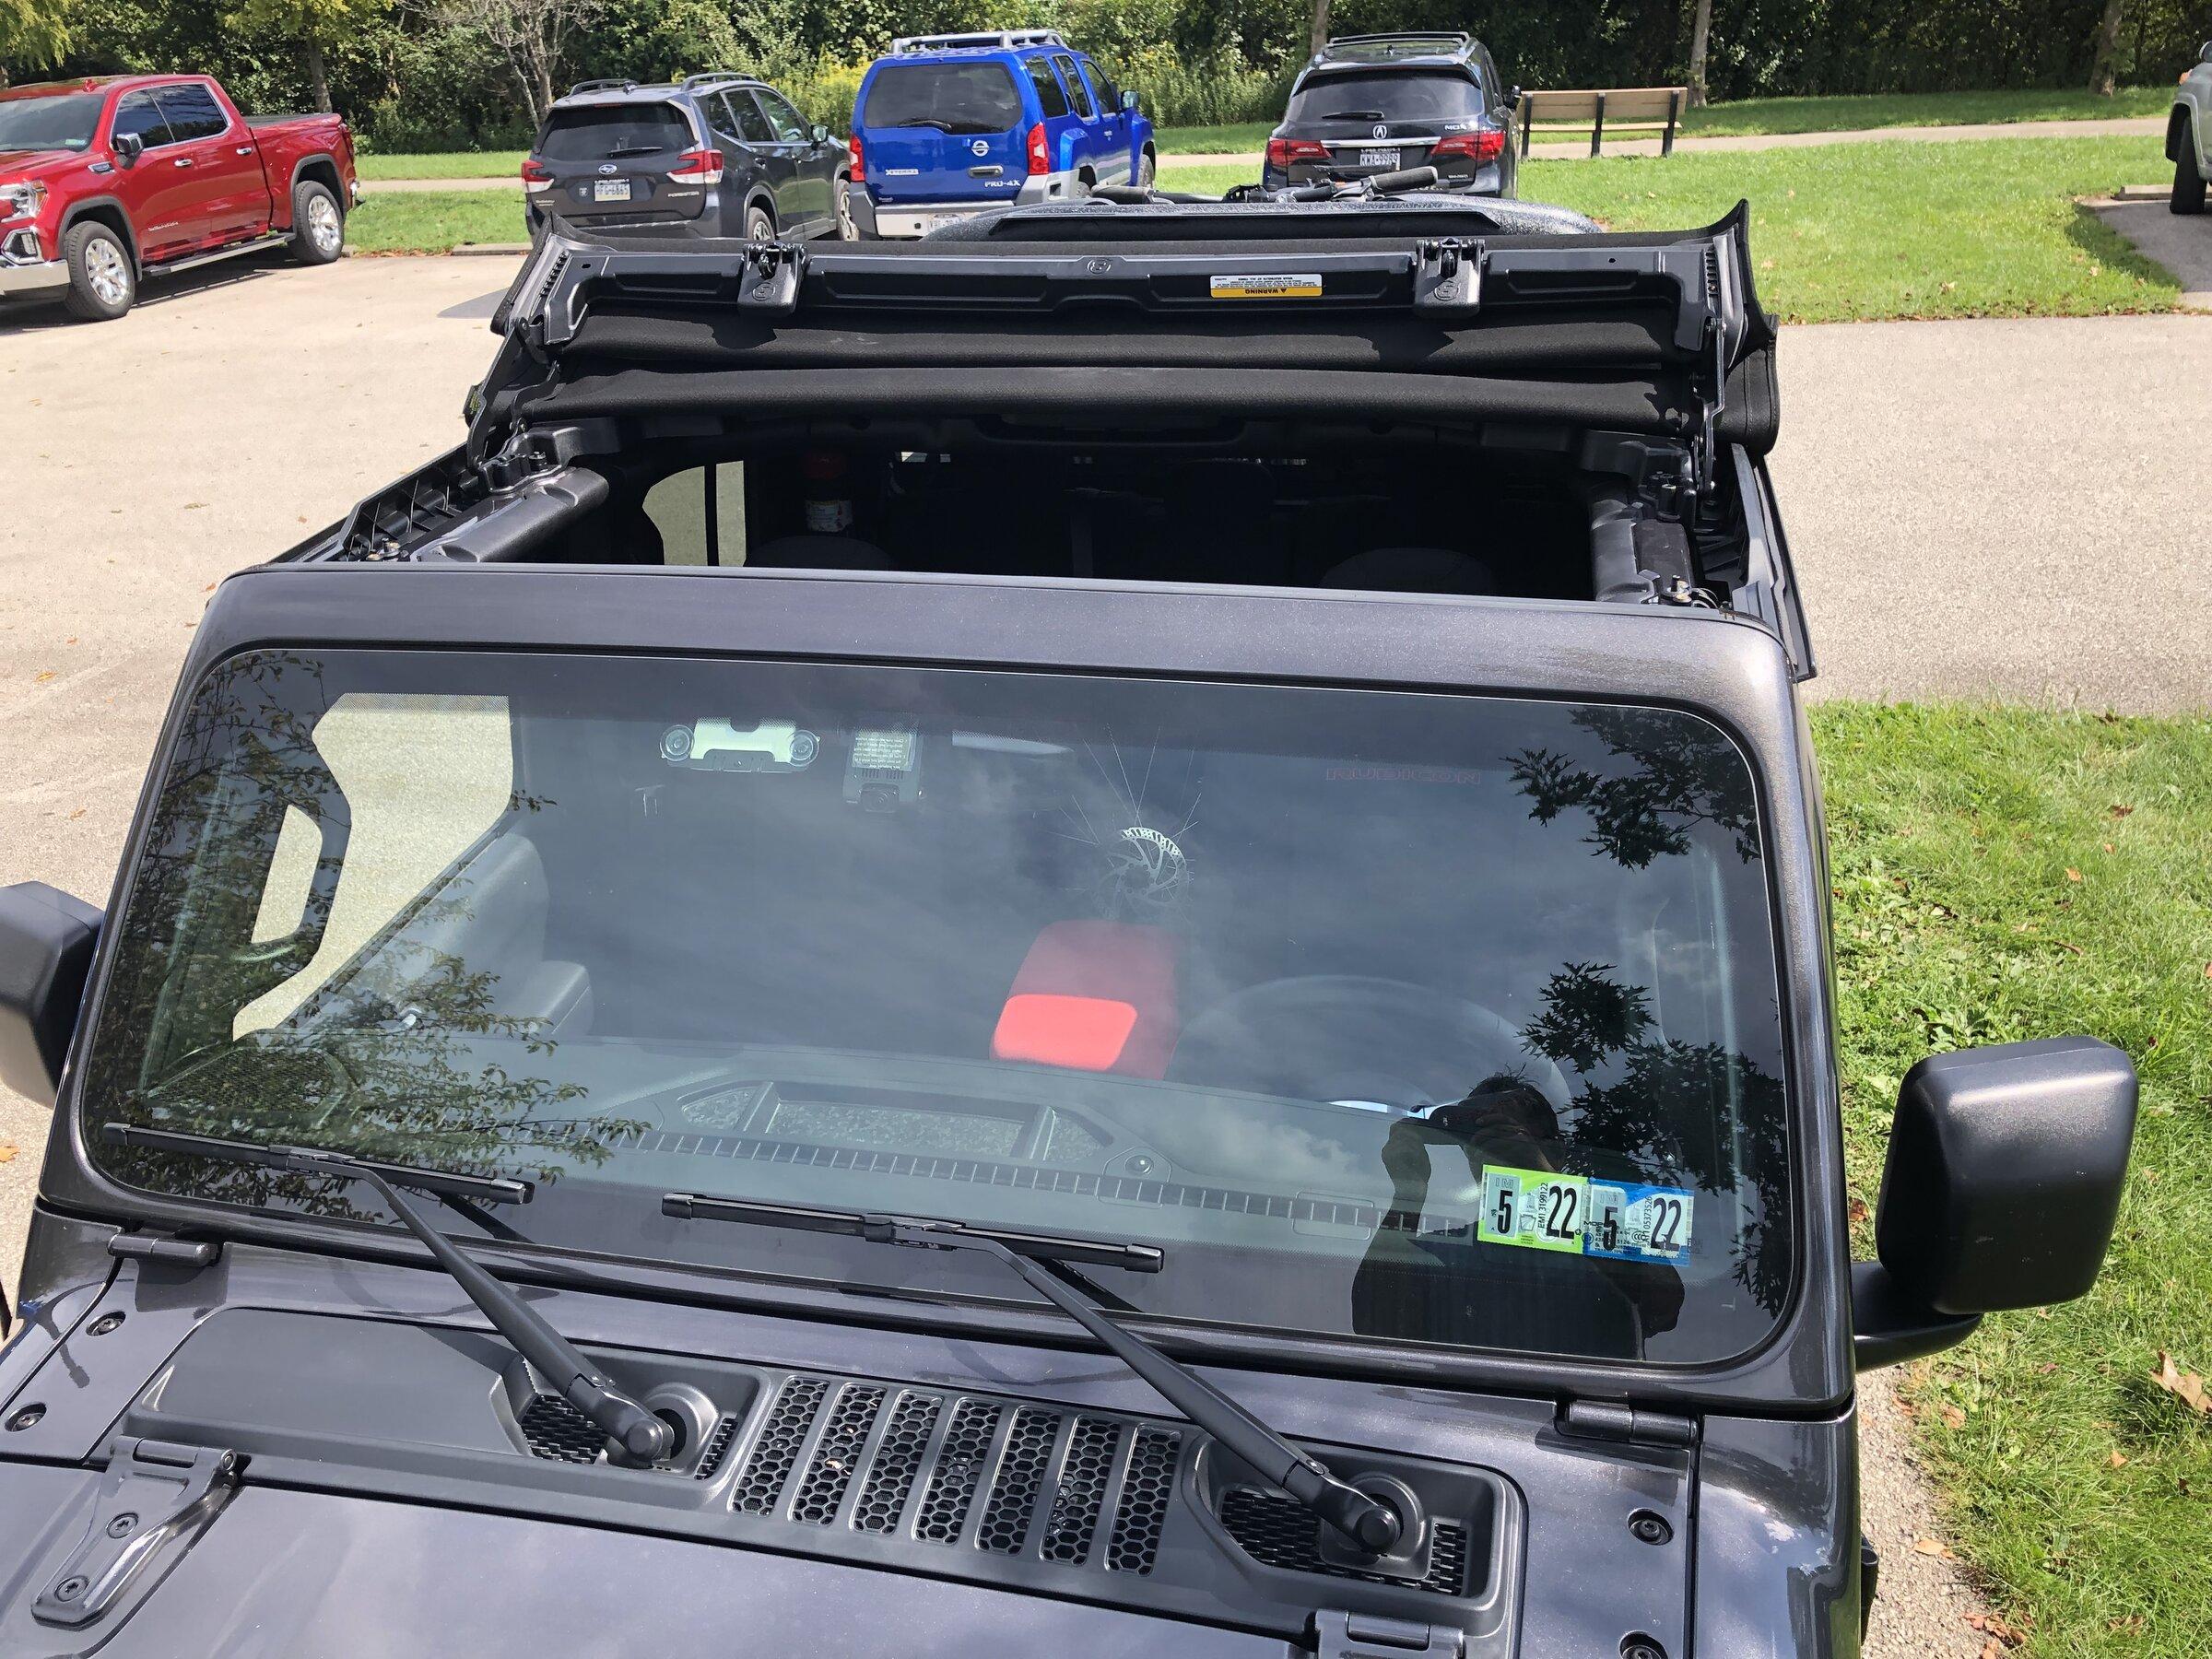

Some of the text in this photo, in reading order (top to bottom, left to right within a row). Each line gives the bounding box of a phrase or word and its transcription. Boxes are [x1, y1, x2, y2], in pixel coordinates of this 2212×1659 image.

[984, 179, 1021, 187] PRO-4X
[1498, 1190, 1512, 1234] 5
[1547, 1185, 1577, 1240] 22
[1603, 1206, 1618, 1251] 5
[1651, 1197, 1682, 1252] 22
